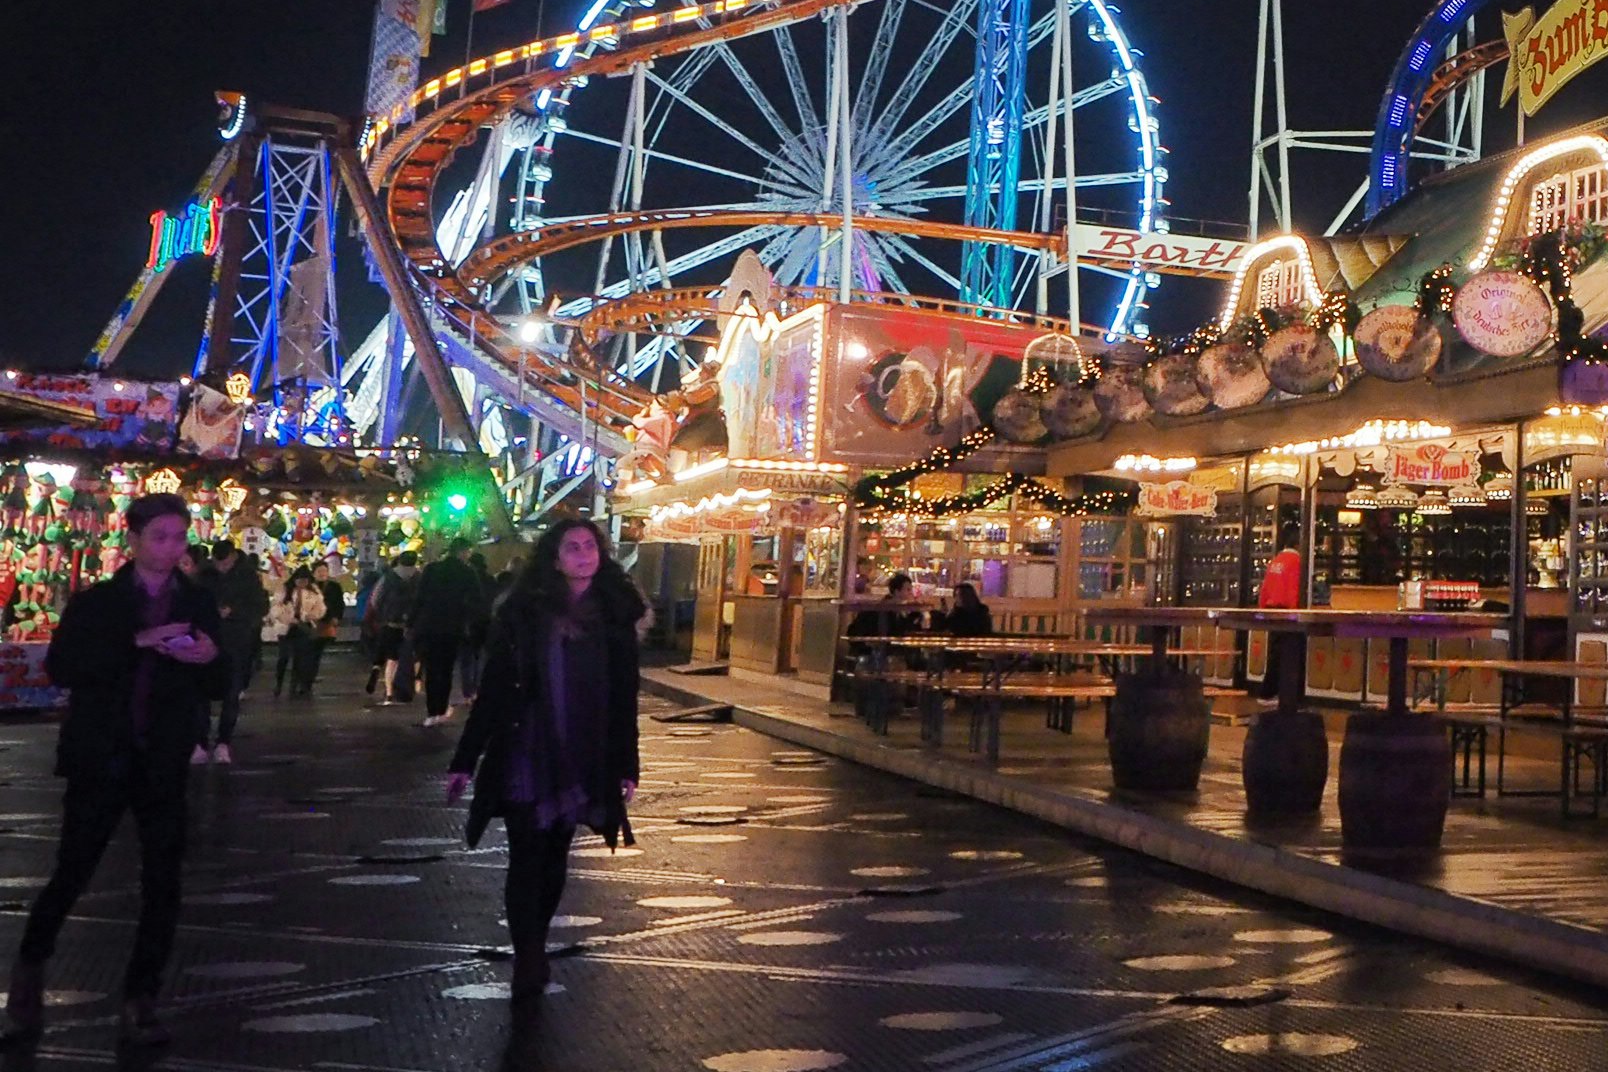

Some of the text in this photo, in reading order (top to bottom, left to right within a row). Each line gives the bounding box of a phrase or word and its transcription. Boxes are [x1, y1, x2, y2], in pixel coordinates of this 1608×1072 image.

[1524, 7, 1589, 98] Zum
[1393, 453, 1470, 481] Jäger Bomb
